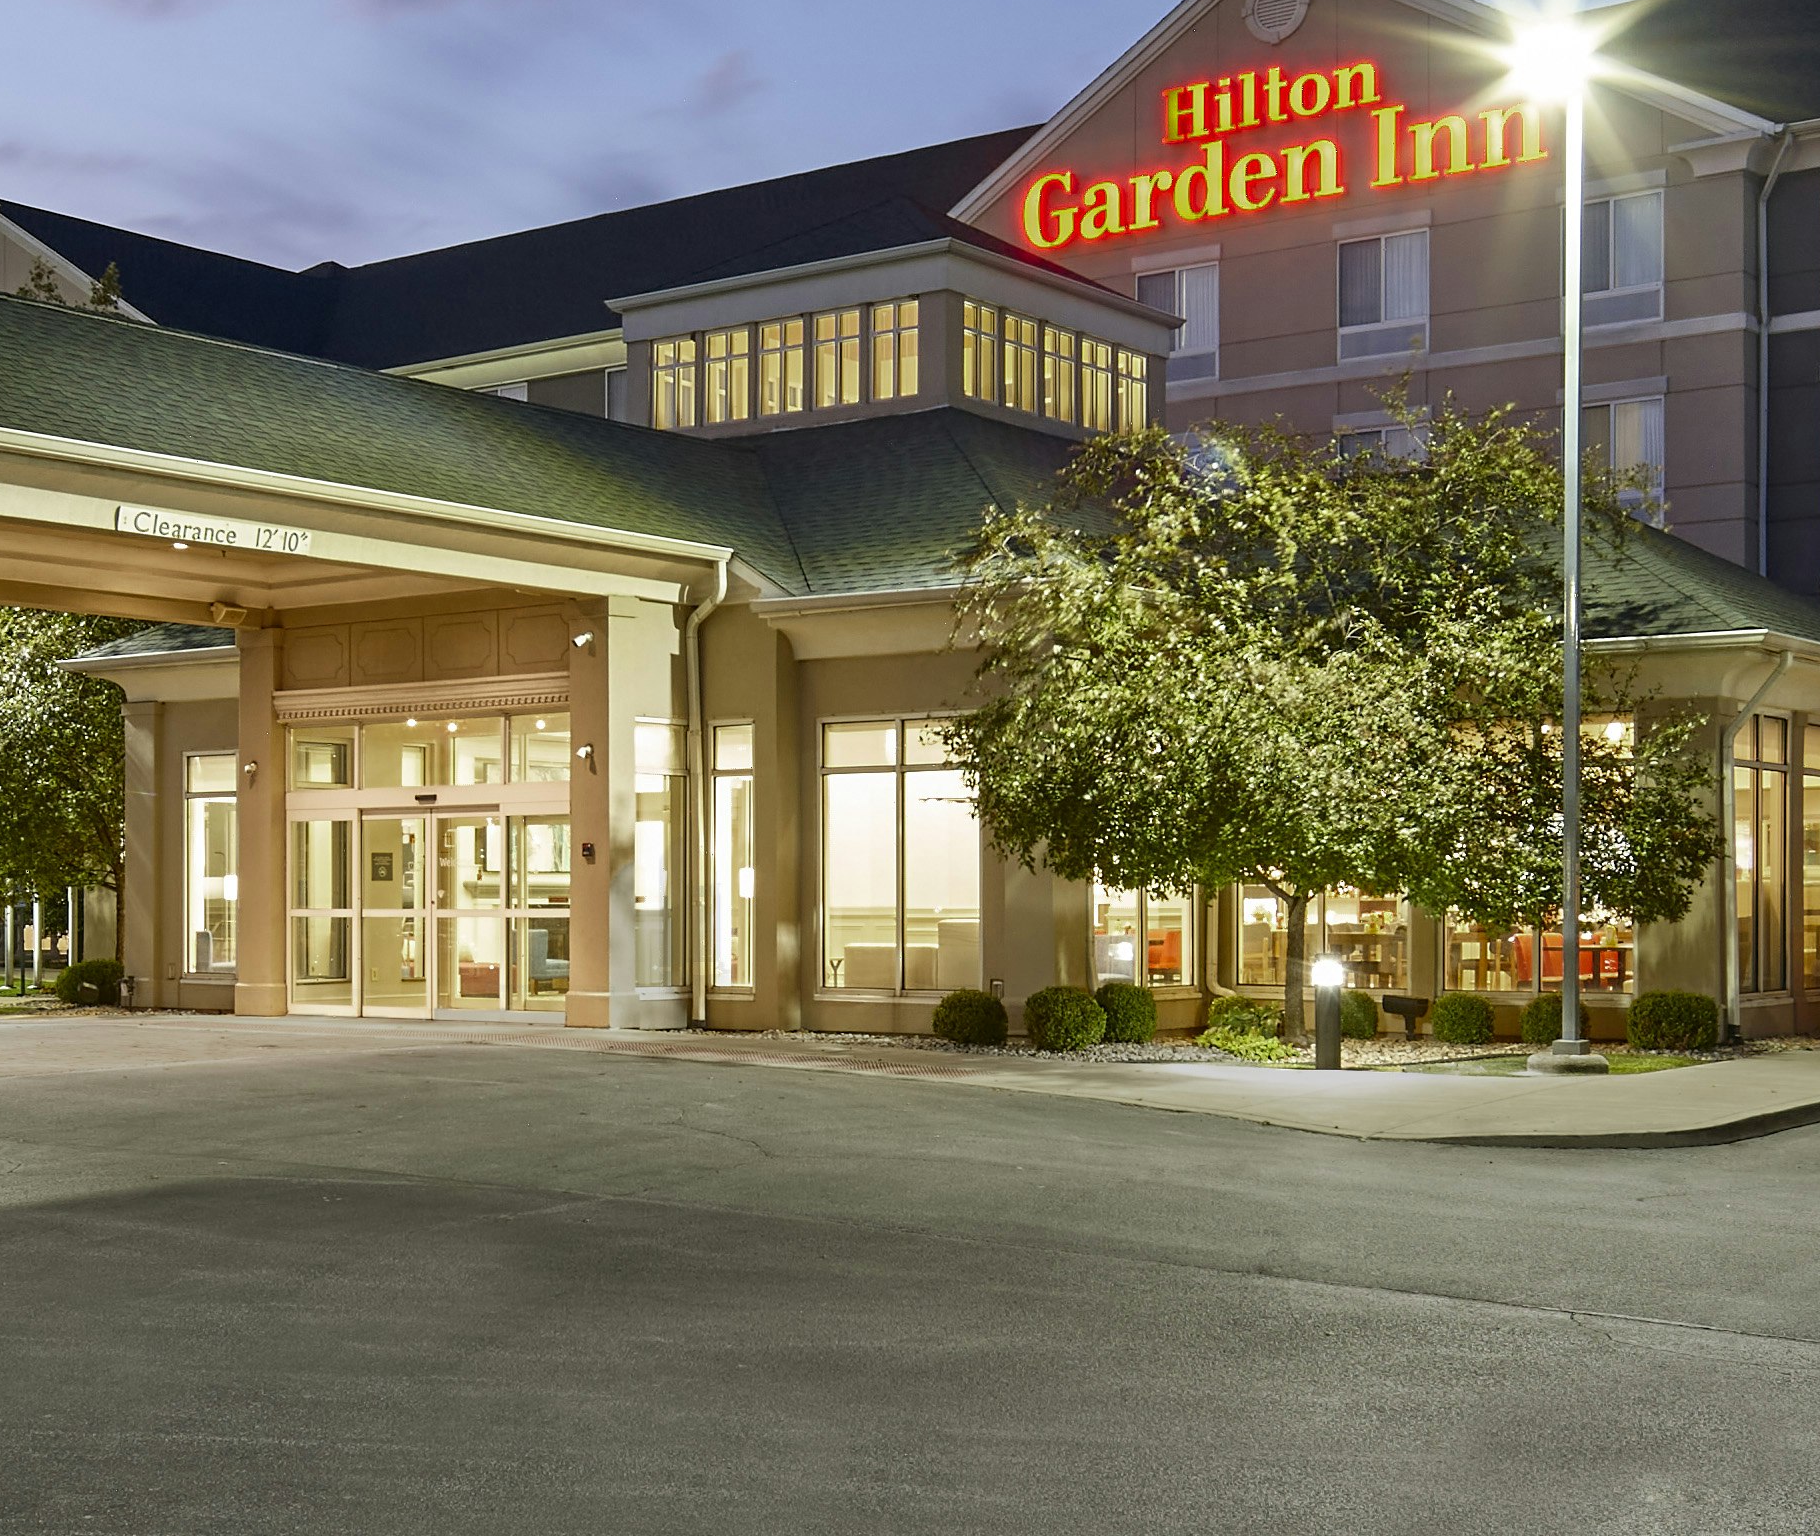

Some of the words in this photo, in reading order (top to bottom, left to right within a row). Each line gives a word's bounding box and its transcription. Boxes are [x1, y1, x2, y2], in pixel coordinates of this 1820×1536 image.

[1162, 61, 1380, 144] Hilton
[1022, 142, 1346, 248] Garden
[1370, 102, 1549, 188] Inn
[133, 511, 238, 545] Clearance
